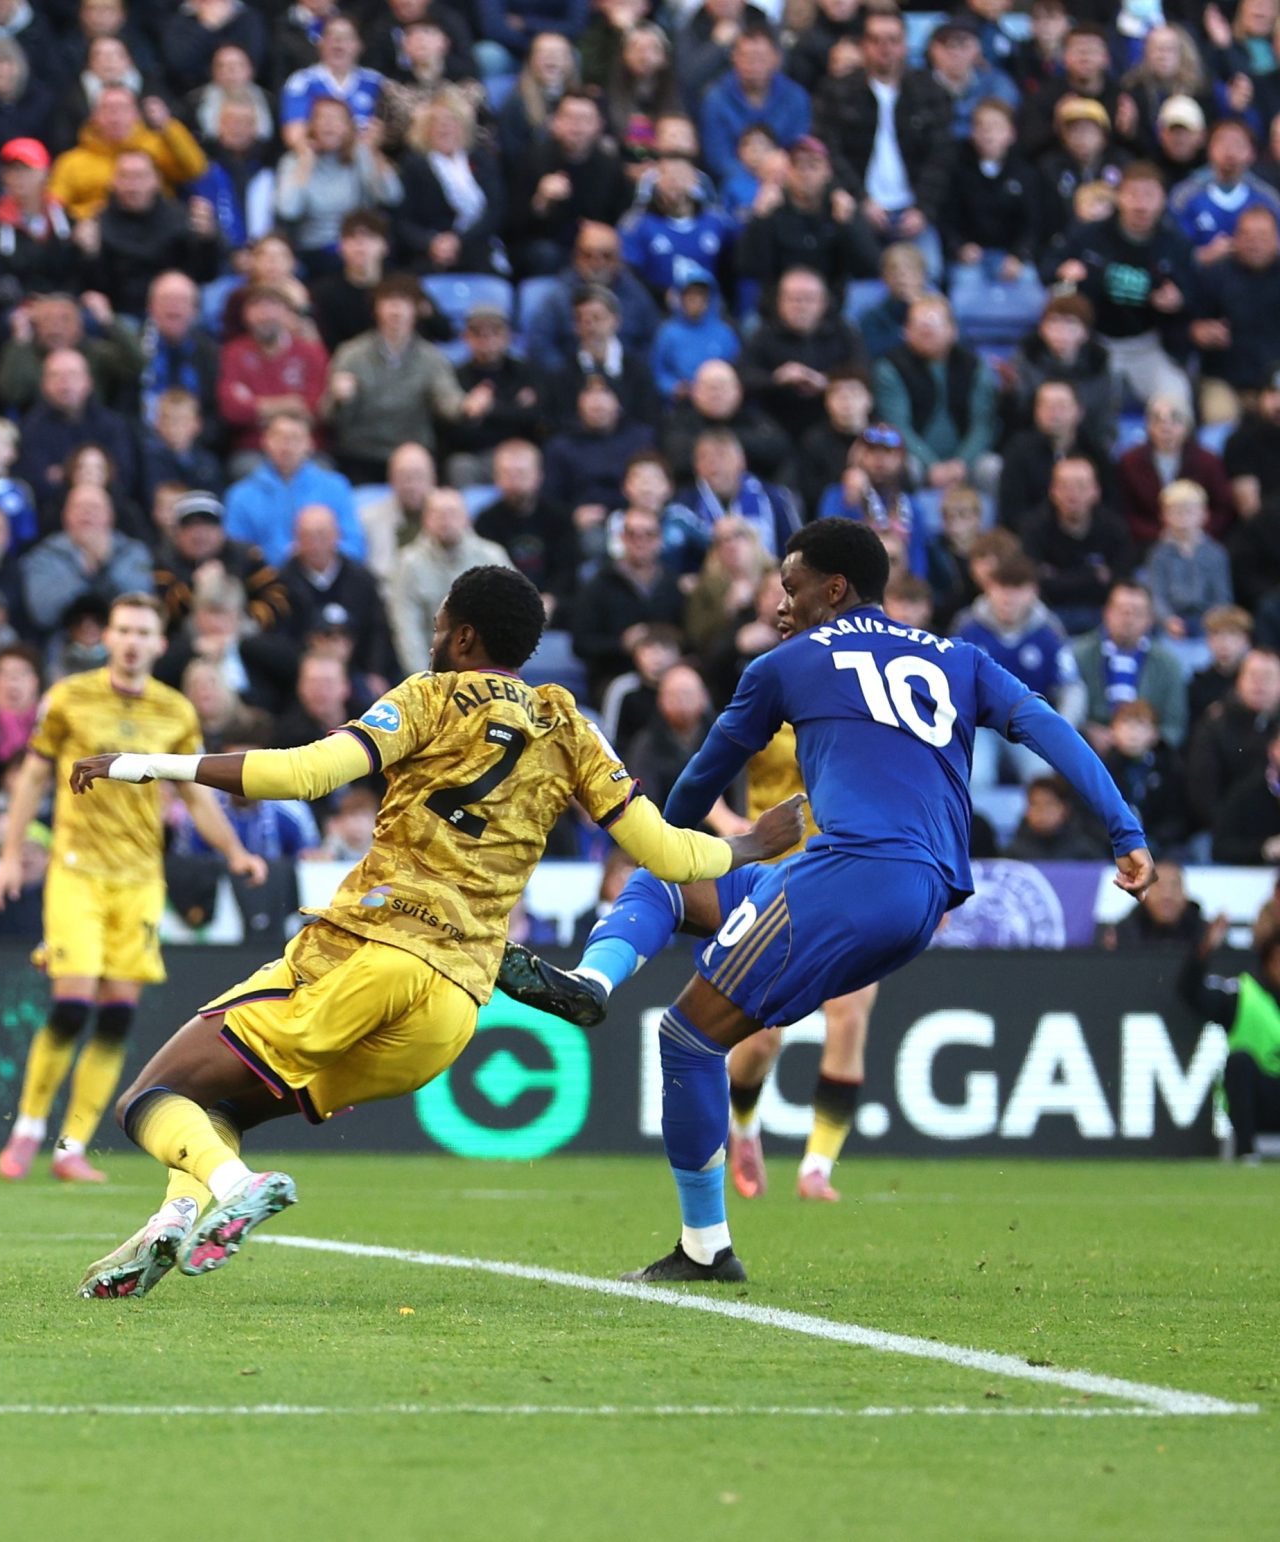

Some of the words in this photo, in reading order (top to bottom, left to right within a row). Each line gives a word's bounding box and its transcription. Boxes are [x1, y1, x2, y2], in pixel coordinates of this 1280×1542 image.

[832, 650, 958, 748] 10
[423, 720, 527, 839] 2
[391, 898, 440, 927] suits
[717, 895, 758, 948] 0
